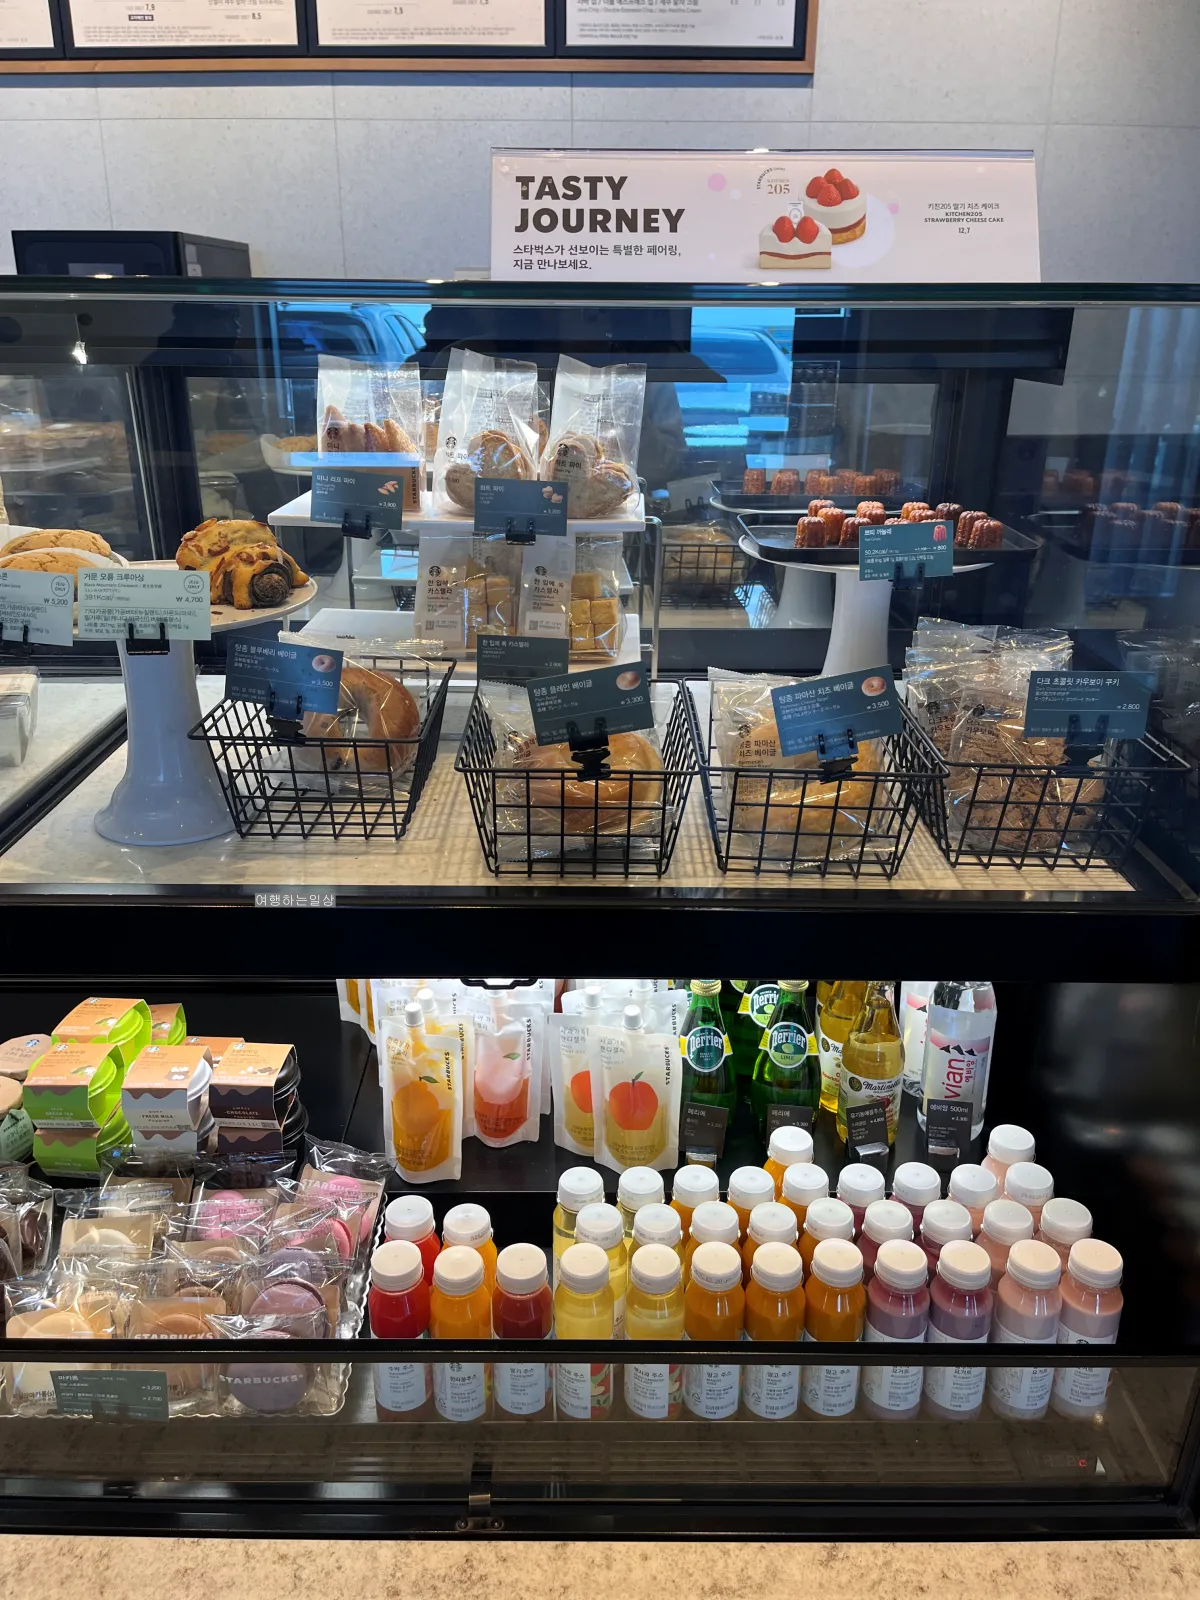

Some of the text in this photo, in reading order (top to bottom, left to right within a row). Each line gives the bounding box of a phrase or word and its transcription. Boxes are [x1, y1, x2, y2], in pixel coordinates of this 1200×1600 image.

[516, 176, 628, 200] TASTY
[767, 184, 790, 194] 205
[515, 208, 685, 234] JOURNEY
[513, 245, 682, 257] 스타벅스가 선보이는 특별한 페어링,
[513, 259, 592, 270] 지금 만나보세요.
[570, 461, 582, 469] 파이
[316, 474, 328, 482] 미니
[344, 477, 356, 485] 파이
[84, 573, 144, 582] 거문 오름 크루아상
[427, 587, 453, 595] 카스텔라
[533, 587, 559, 595] 카스텔라
[250, 646, 276, 657] 블루베리
[278, 649, 297, 660] 베이글
[316, 678, 334, 687] 3,500
[1053, 678, 1074, 686] 초콜릿
[1075, 678, 1103, 686] 카우보이
[1105, 678, 1120, 686] 쿠키
[534, 679, 593, 697] 탕종 플레인 베이글
[795, 691, 816, 701] 파마산
[818, 687, 832, 695] 치즈
[833, 682, 854, 692] 베이글
[626, 696, 644, 705] 3,300
[872, 700, 890, 709] 3,500
[754, 740, 776, 748] 파마산
[754, 749, 776, 757] 베이글
[965, 1060, 975, 1083] 에비앙
[942, 1058, 965, 1099] vian
[687, 1108, 706, 1117] 페리에
[219, 1374, 299, 1384] STARBUCKS
